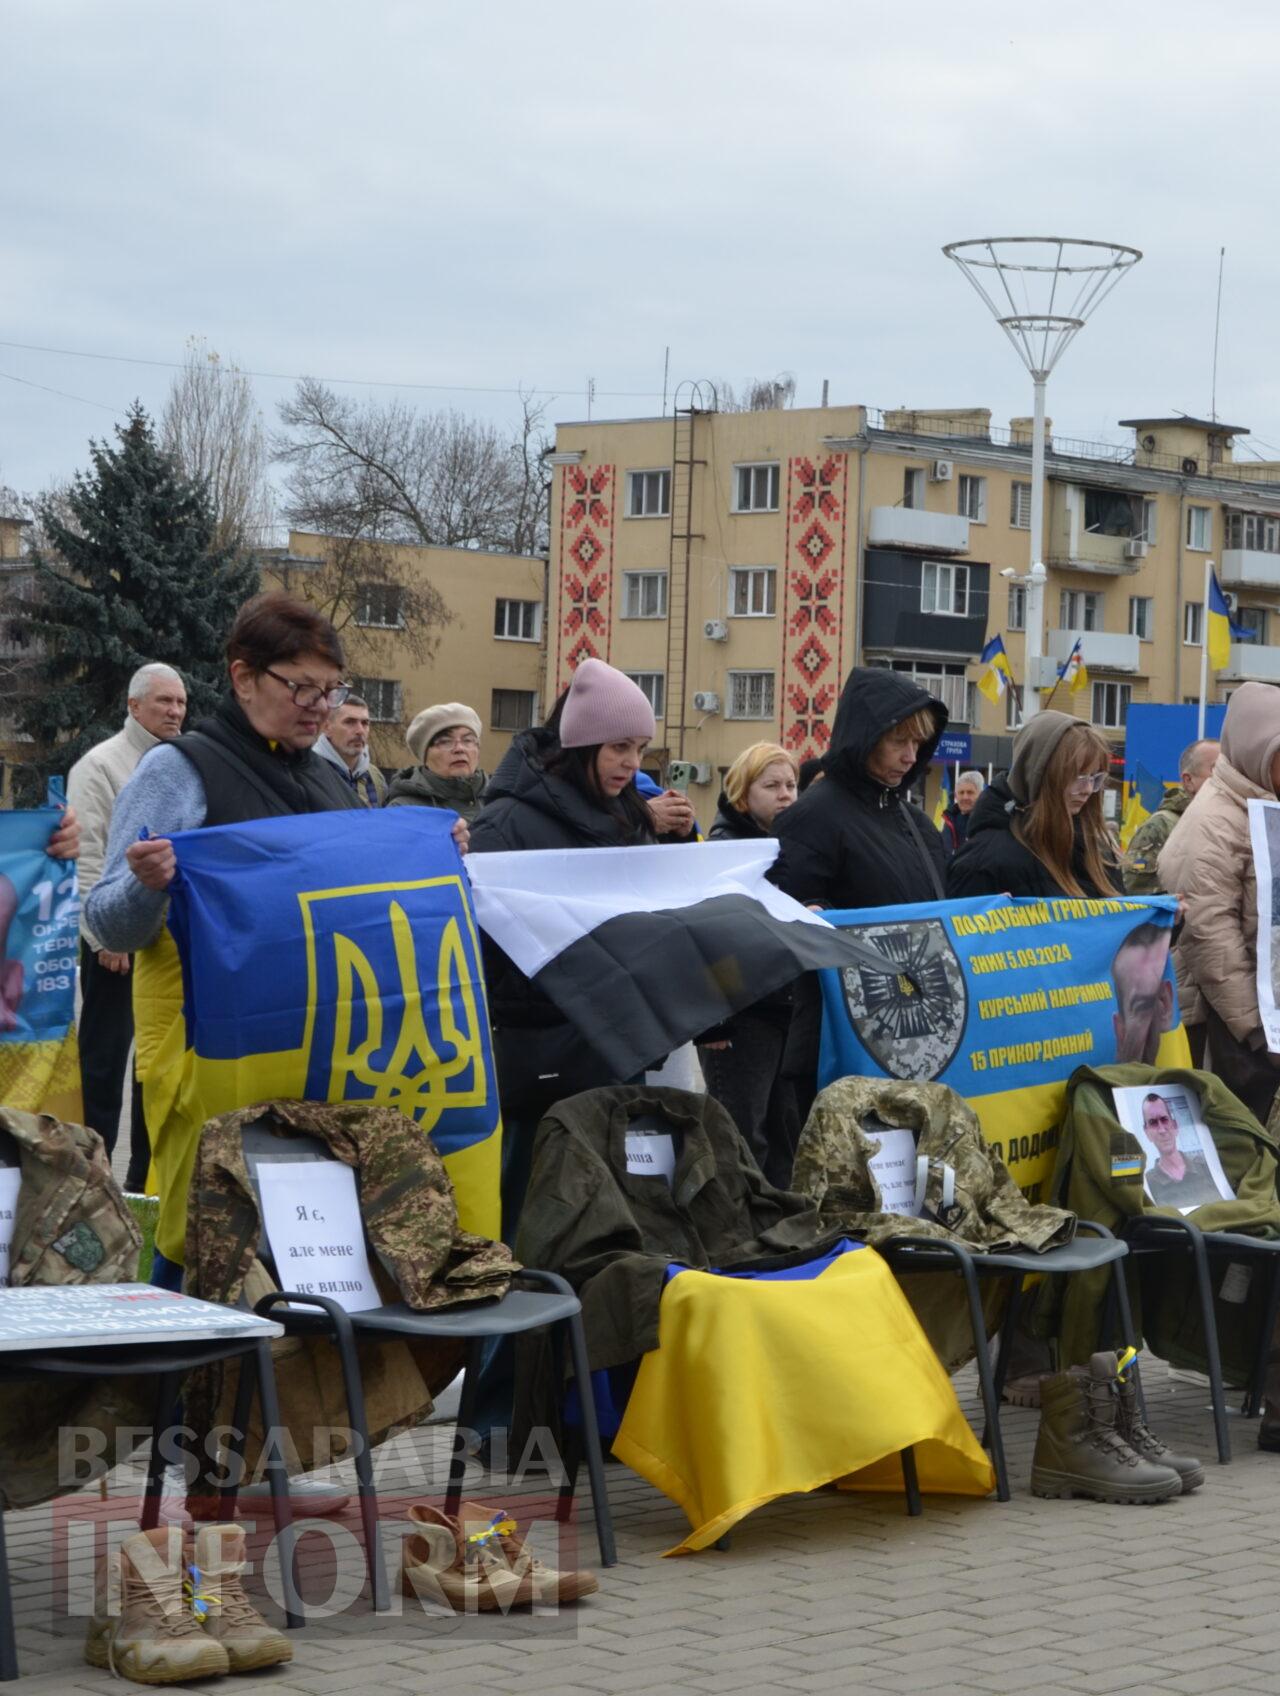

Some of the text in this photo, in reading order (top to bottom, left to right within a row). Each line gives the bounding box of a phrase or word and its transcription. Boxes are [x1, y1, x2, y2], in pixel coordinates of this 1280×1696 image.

[952, 898, 1051, 936] ПОДДУБНИЙ
[970, 943, 1072, 975] ЗНИК 5.09.2024
[36, 974, 70, 992] 183
[979, 981, 1113, 1020] КУРСЬКИЙ НАПРЯМОК
[970, 1028, 1094, 1071] 15 ПРИКОРДОННИЙ
[296, 1206, 308, 1221] Я
[289, 1244, 355, 1258] але мене
[297, 1281, 364, 1295] не видно
